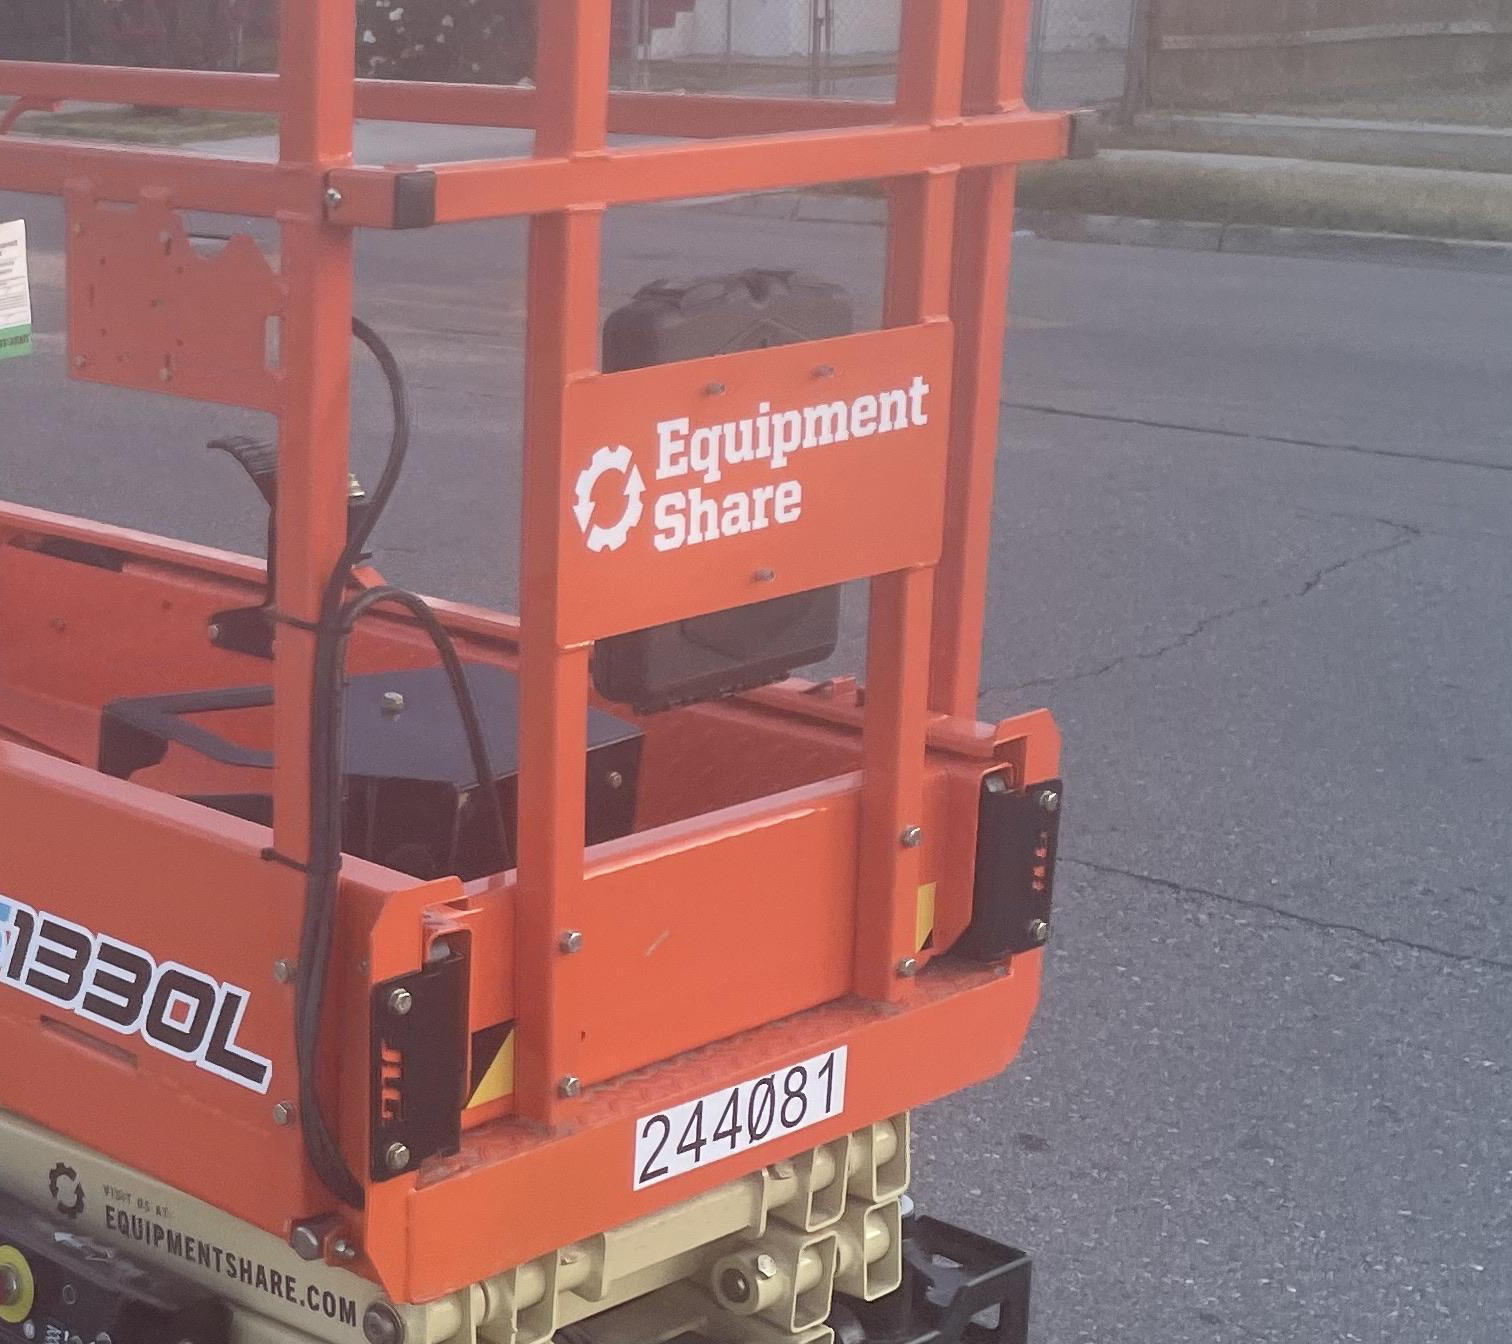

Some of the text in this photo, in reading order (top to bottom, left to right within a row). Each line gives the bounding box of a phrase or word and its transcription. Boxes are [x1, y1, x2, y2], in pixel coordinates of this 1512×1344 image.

[655, 375, 930, 484] Equipment
[652, 479, 802, 553] Share
[638, 1051, 838, 1186] 244081
[105, 1204, 357, 1328] EQUIPMENTSHARE.COM
